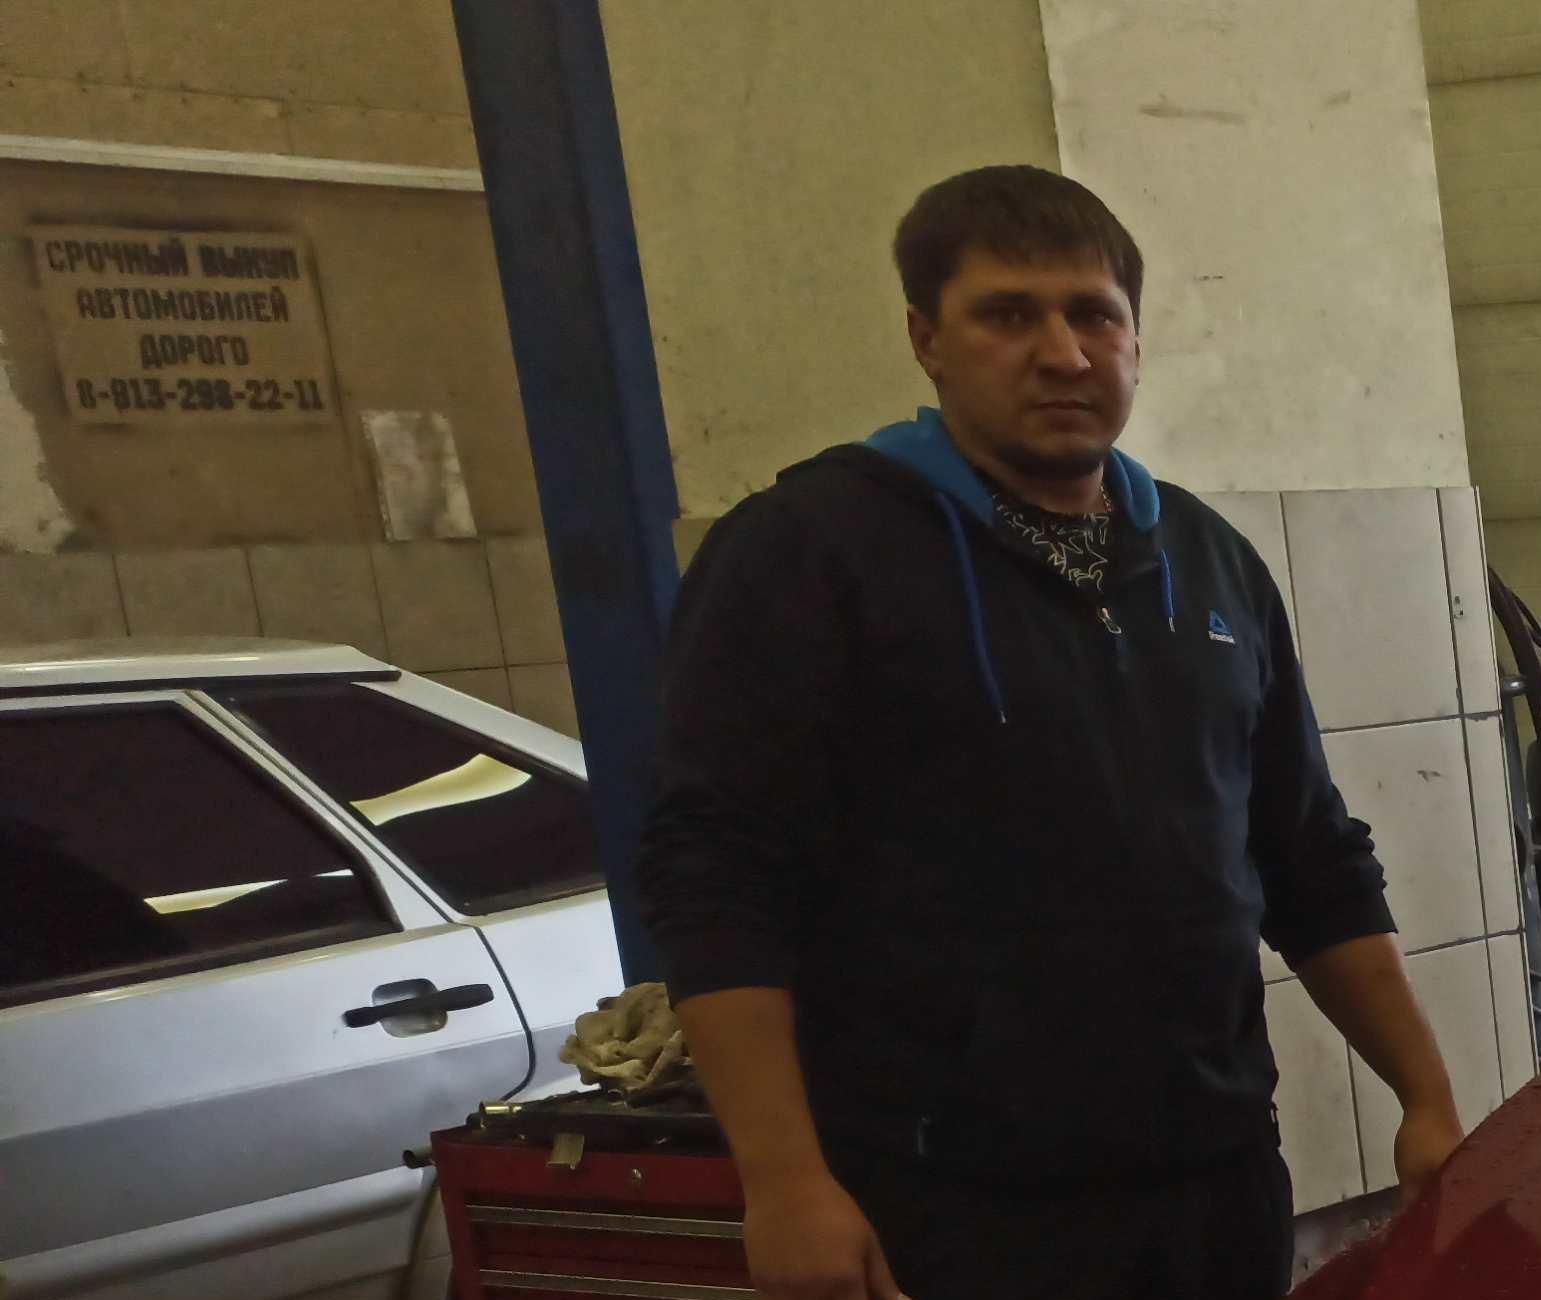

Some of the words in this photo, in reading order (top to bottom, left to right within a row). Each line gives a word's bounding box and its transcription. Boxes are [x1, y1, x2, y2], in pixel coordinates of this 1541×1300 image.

[46, 238, 190, 277] СРОЧНЫЙ
[76, 285, 290, 323] АВТОМОБИЛЕЙ
[139, 333, 250, 370] ДОРОГО
